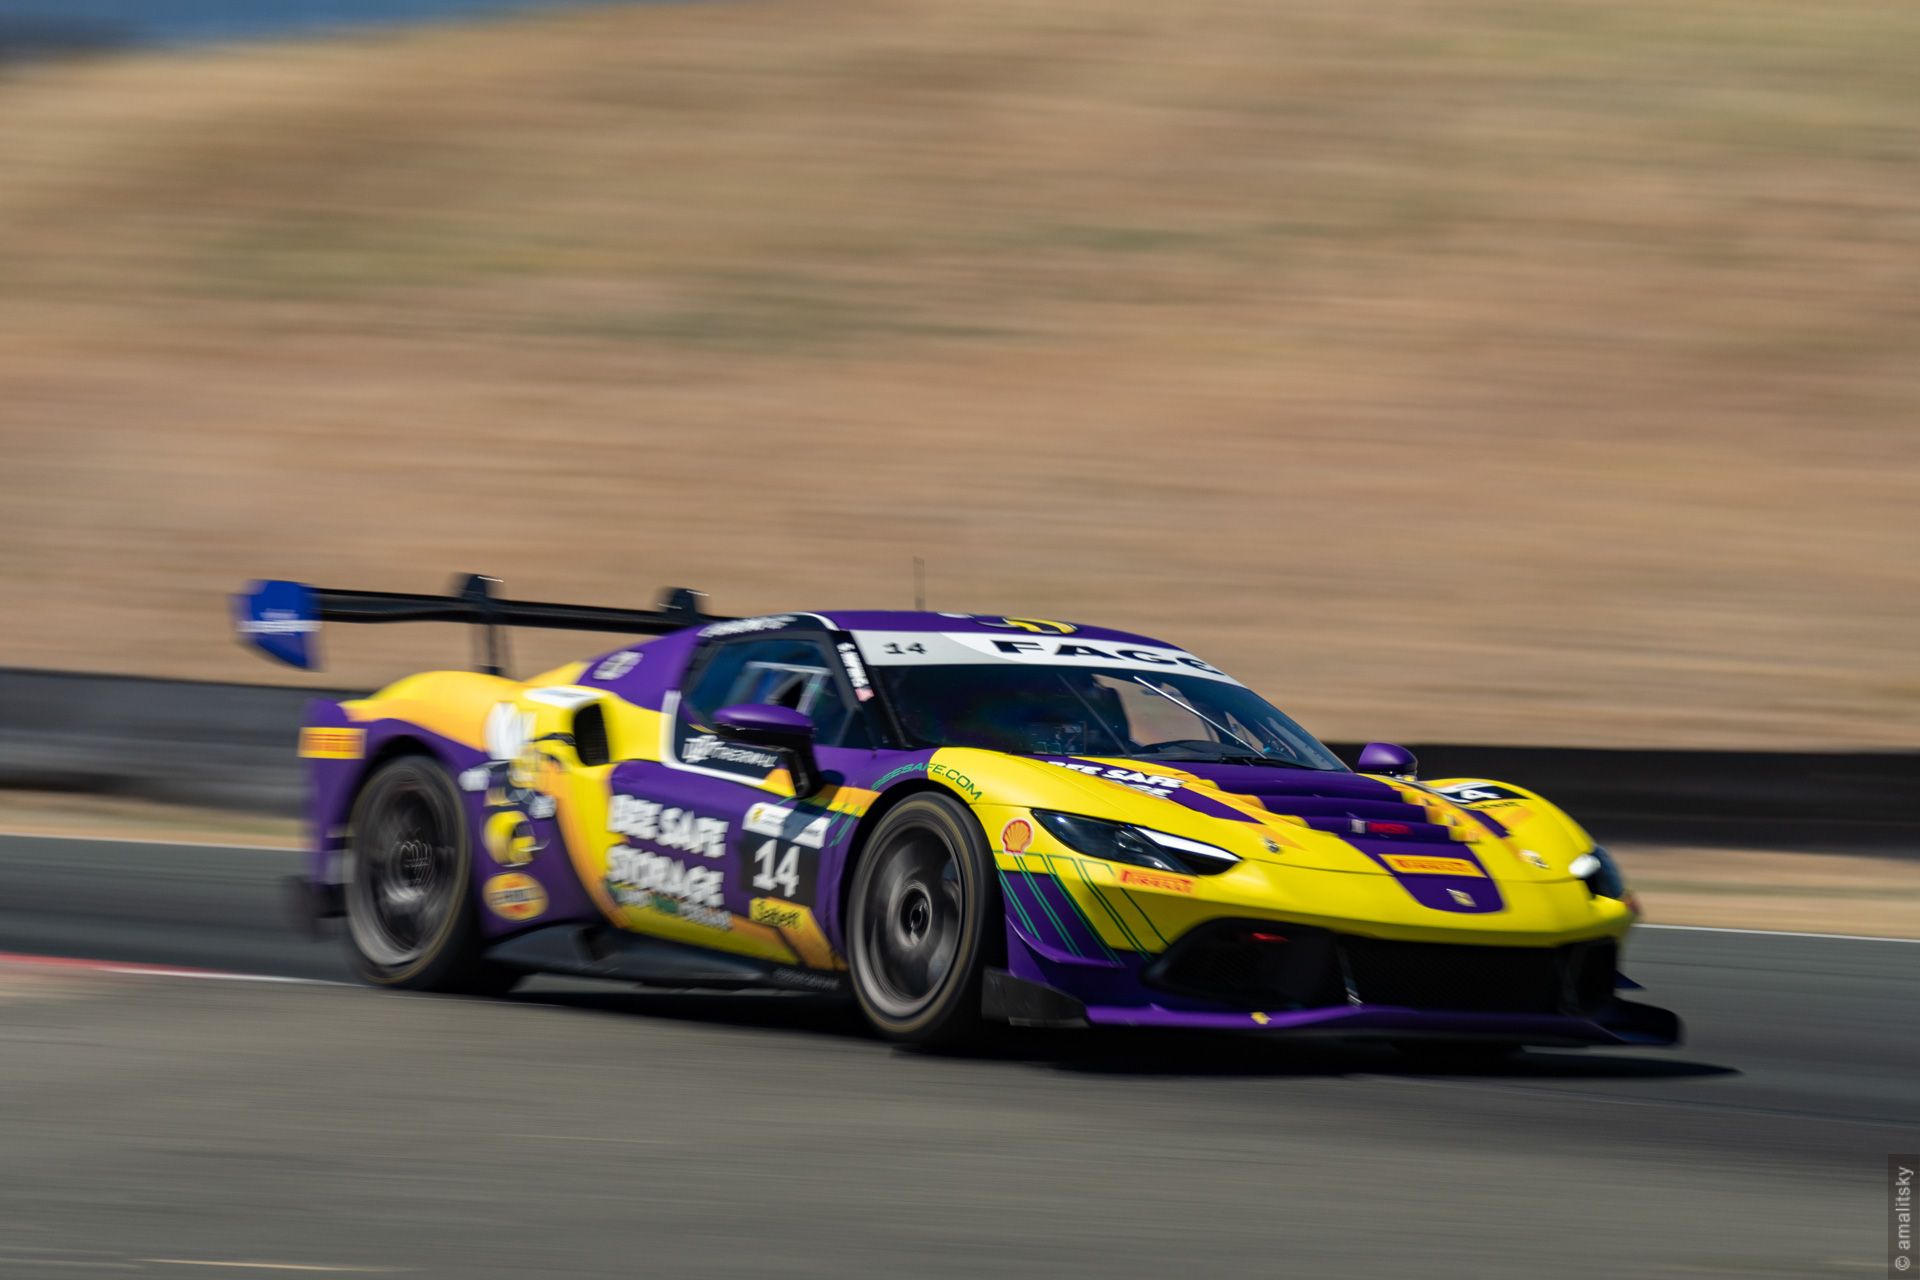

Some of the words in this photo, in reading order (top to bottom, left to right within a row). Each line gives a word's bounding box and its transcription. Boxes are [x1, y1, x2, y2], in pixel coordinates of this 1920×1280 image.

[882, 642, 927, 655] 14
[1101, 769, 1186, 789] SAFE
[655, 807, 730, 858] SAFE
[606, 845, 725, 906] STORAGE
[752, 838, 801, 898] 14
